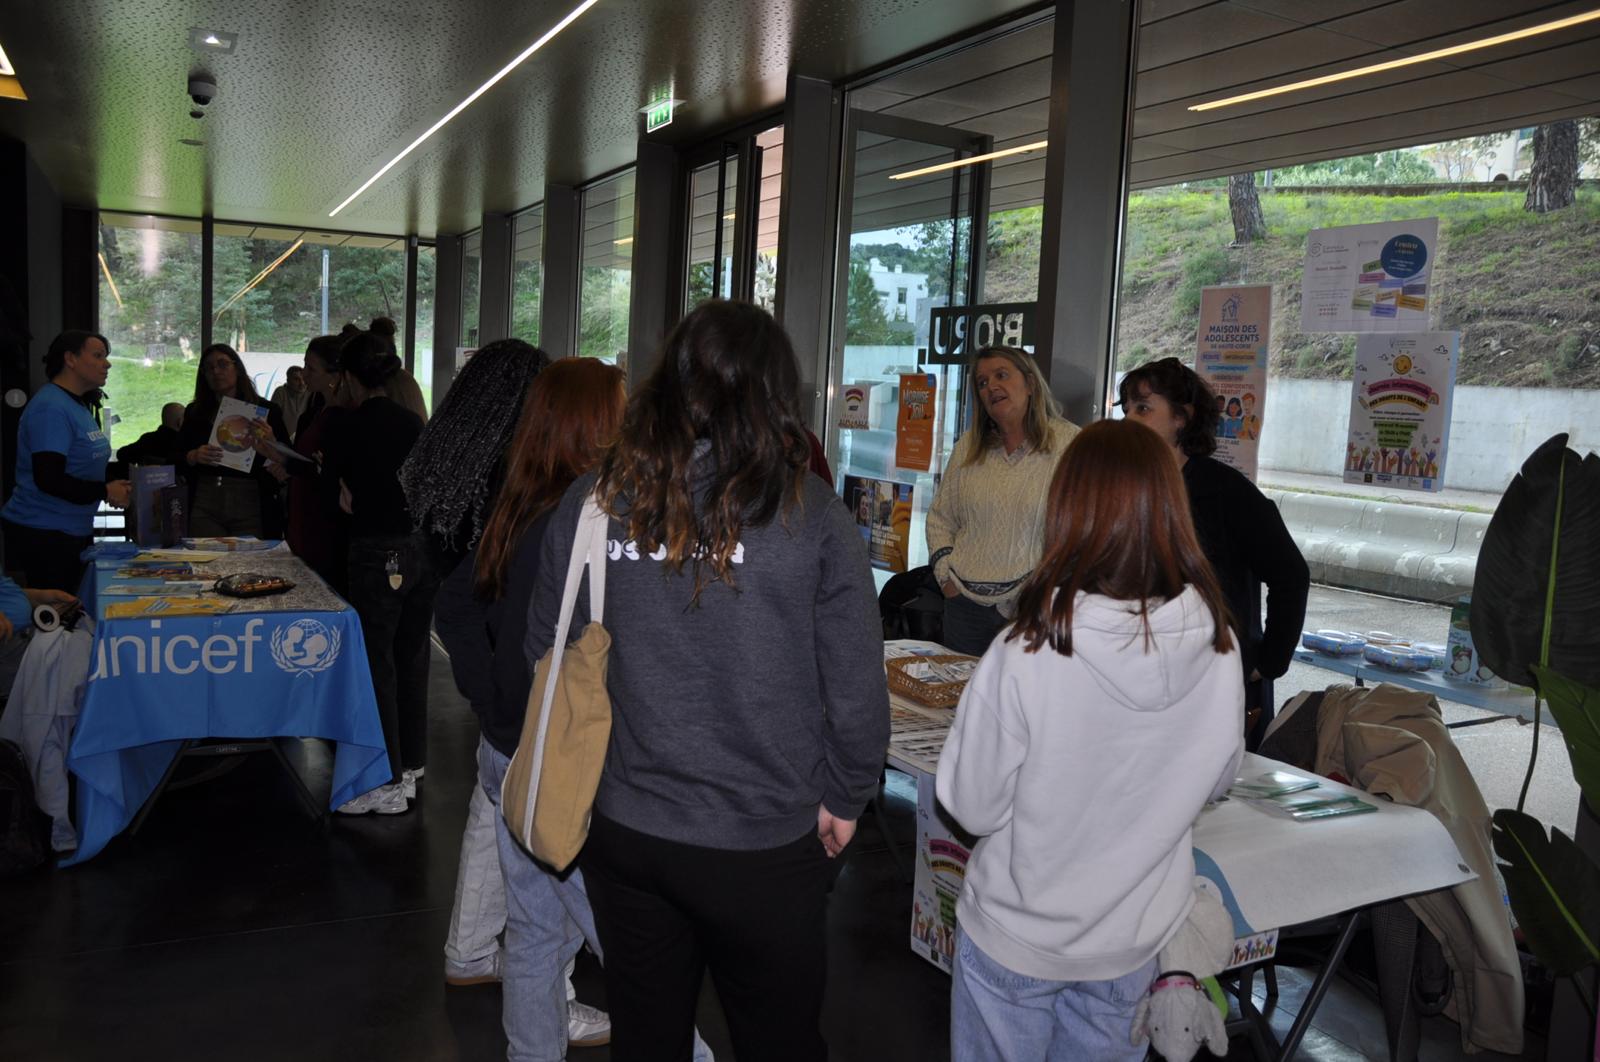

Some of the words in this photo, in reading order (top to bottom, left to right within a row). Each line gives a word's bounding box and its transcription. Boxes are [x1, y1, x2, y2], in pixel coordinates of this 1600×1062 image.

[1209, 325, 1240, 334] MAISON
[1241, 324, 1257, 333] DES
[1204, 334, 1260, 342] ADOLESCENTS
